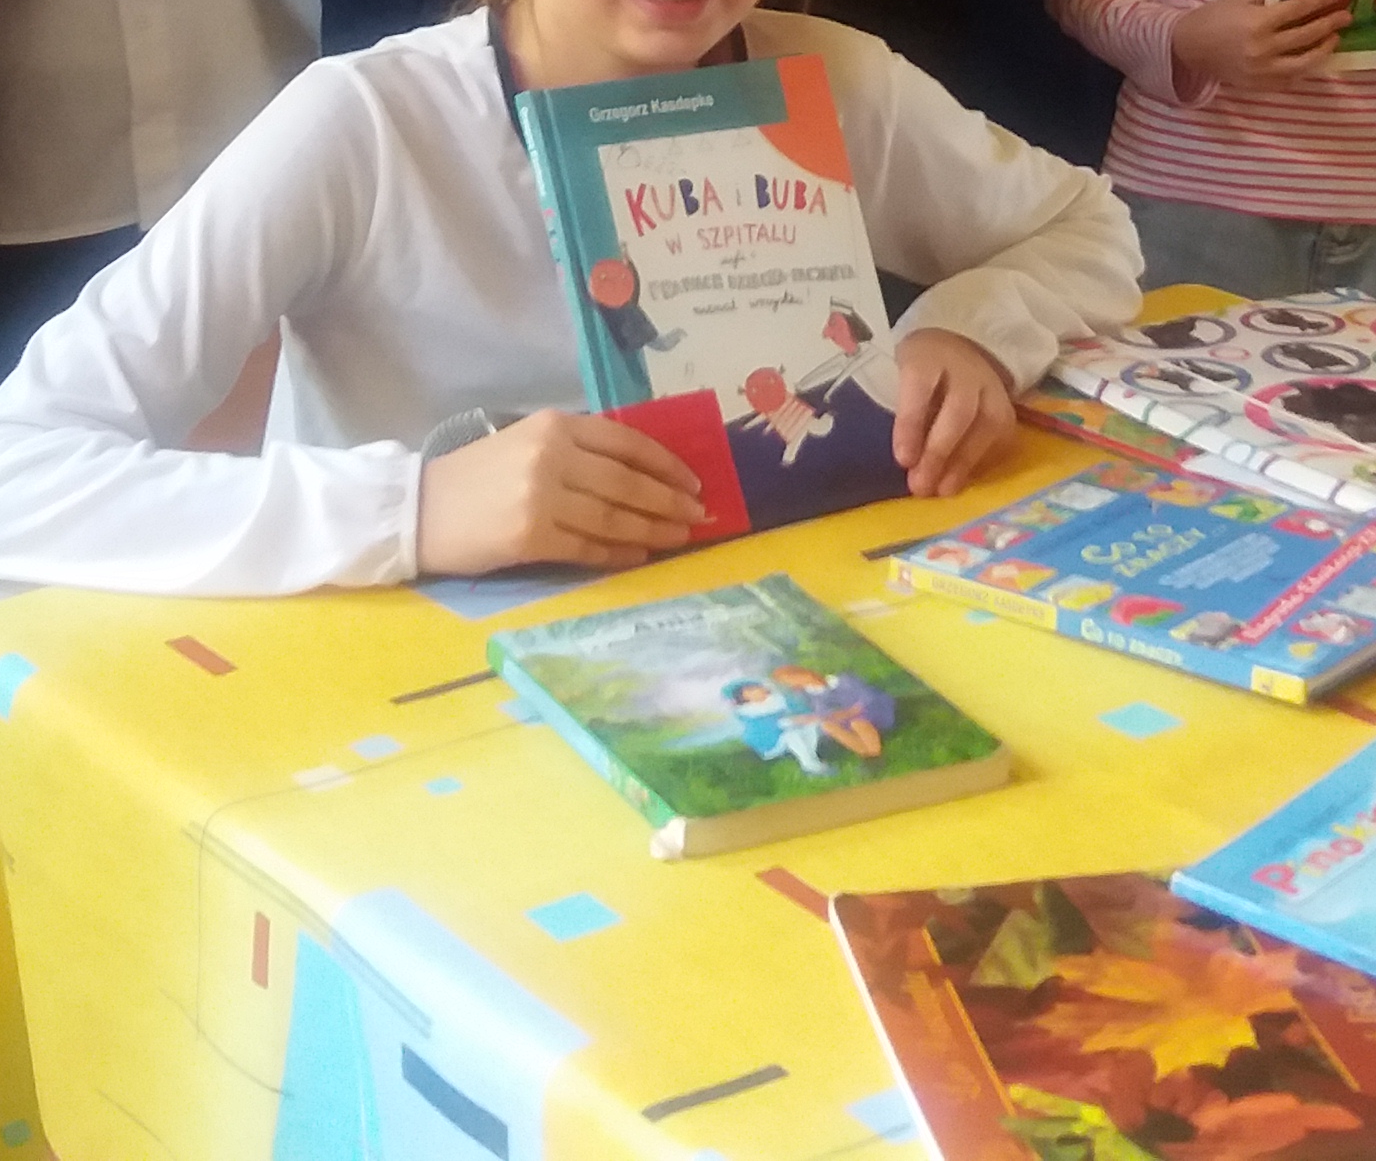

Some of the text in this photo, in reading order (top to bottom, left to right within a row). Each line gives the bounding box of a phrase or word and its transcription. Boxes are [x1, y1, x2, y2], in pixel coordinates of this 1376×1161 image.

[588, 103, 650, 123] Grzegorz
[625, 177, 724, 237] KUBA
[754, 173, 828, 217] BUBA
[697, 223, 797, 251] SZPITALU
